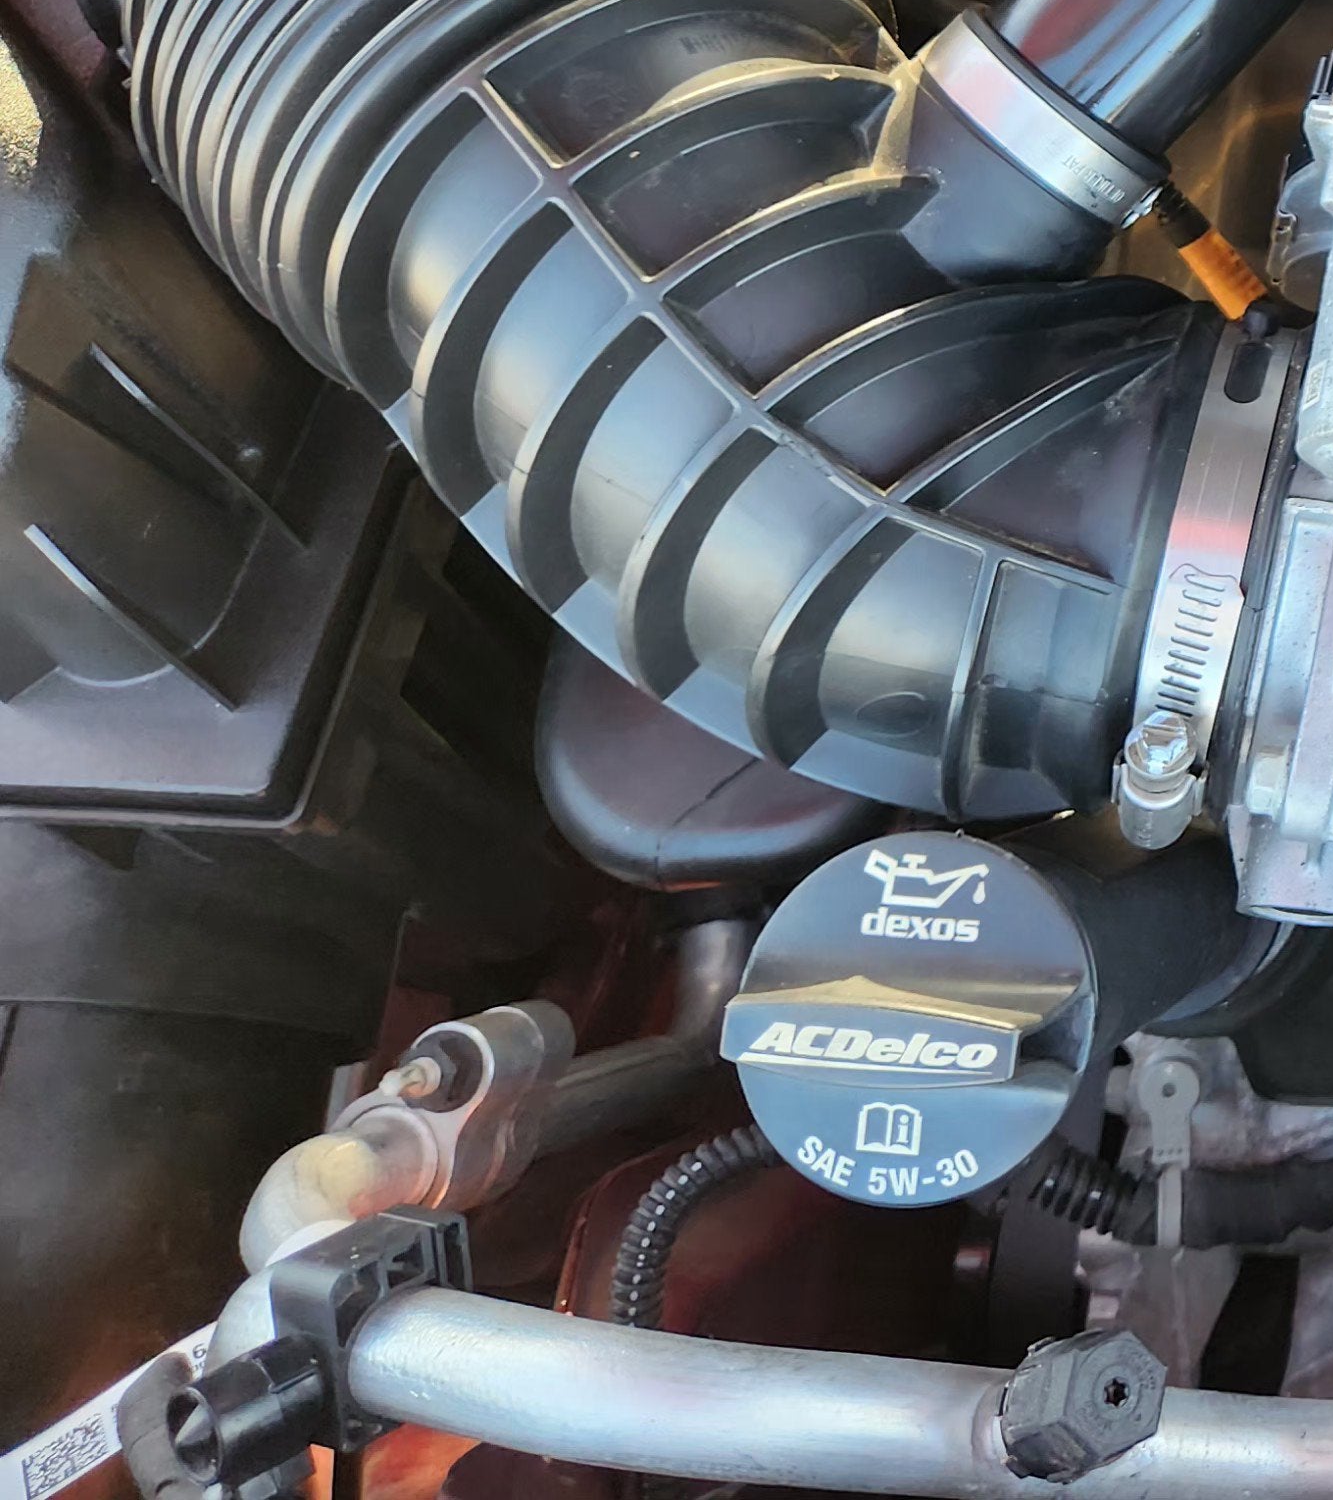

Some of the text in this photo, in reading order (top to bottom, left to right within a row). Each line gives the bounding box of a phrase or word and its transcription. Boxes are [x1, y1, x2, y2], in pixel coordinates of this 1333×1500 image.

[861, 907, 980, 943] dexos
[750, 1021, 998, 1069] ACDelco
[797, 1136, 979, 1197] SAE 5W-30
